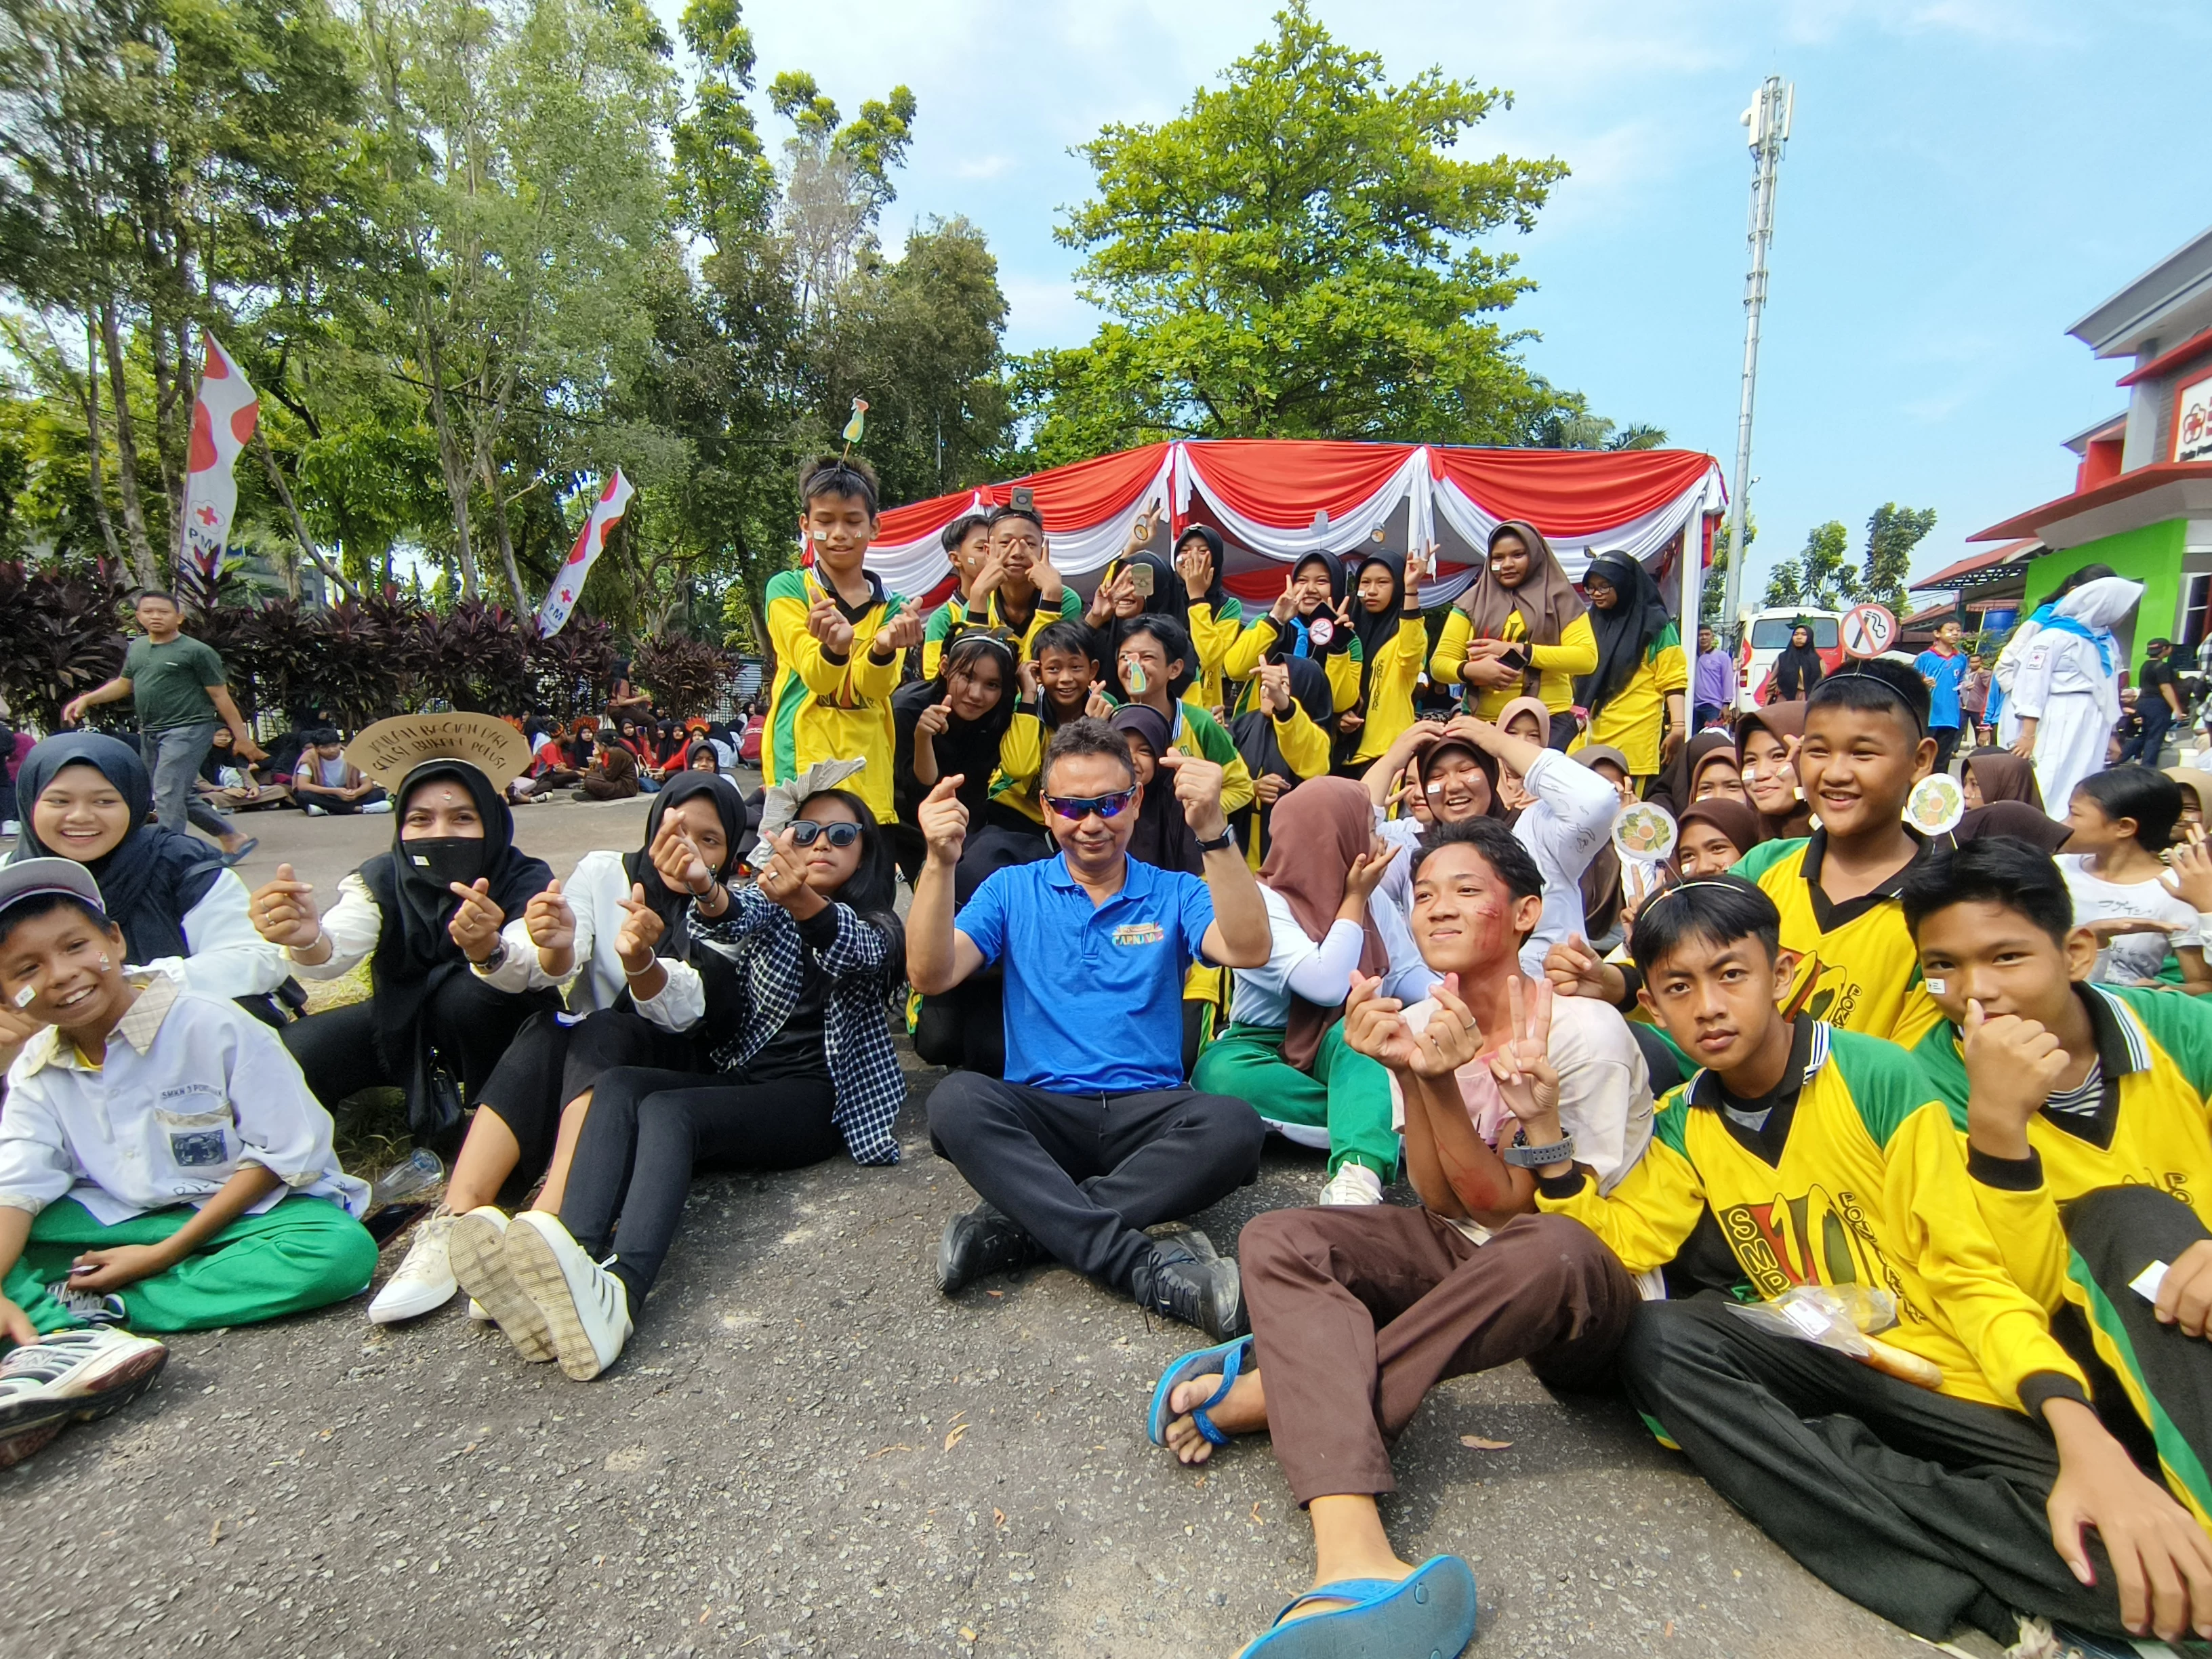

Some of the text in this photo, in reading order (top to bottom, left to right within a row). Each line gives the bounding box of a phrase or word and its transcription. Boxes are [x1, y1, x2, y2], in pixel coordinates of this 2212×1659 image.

[419, 722, 478, 737] BAGIAN
[480, 726, 510, 750] DARI
[411, 737, 463, 752] BUKAN
[470, 741, 507, 770] POLUSI
